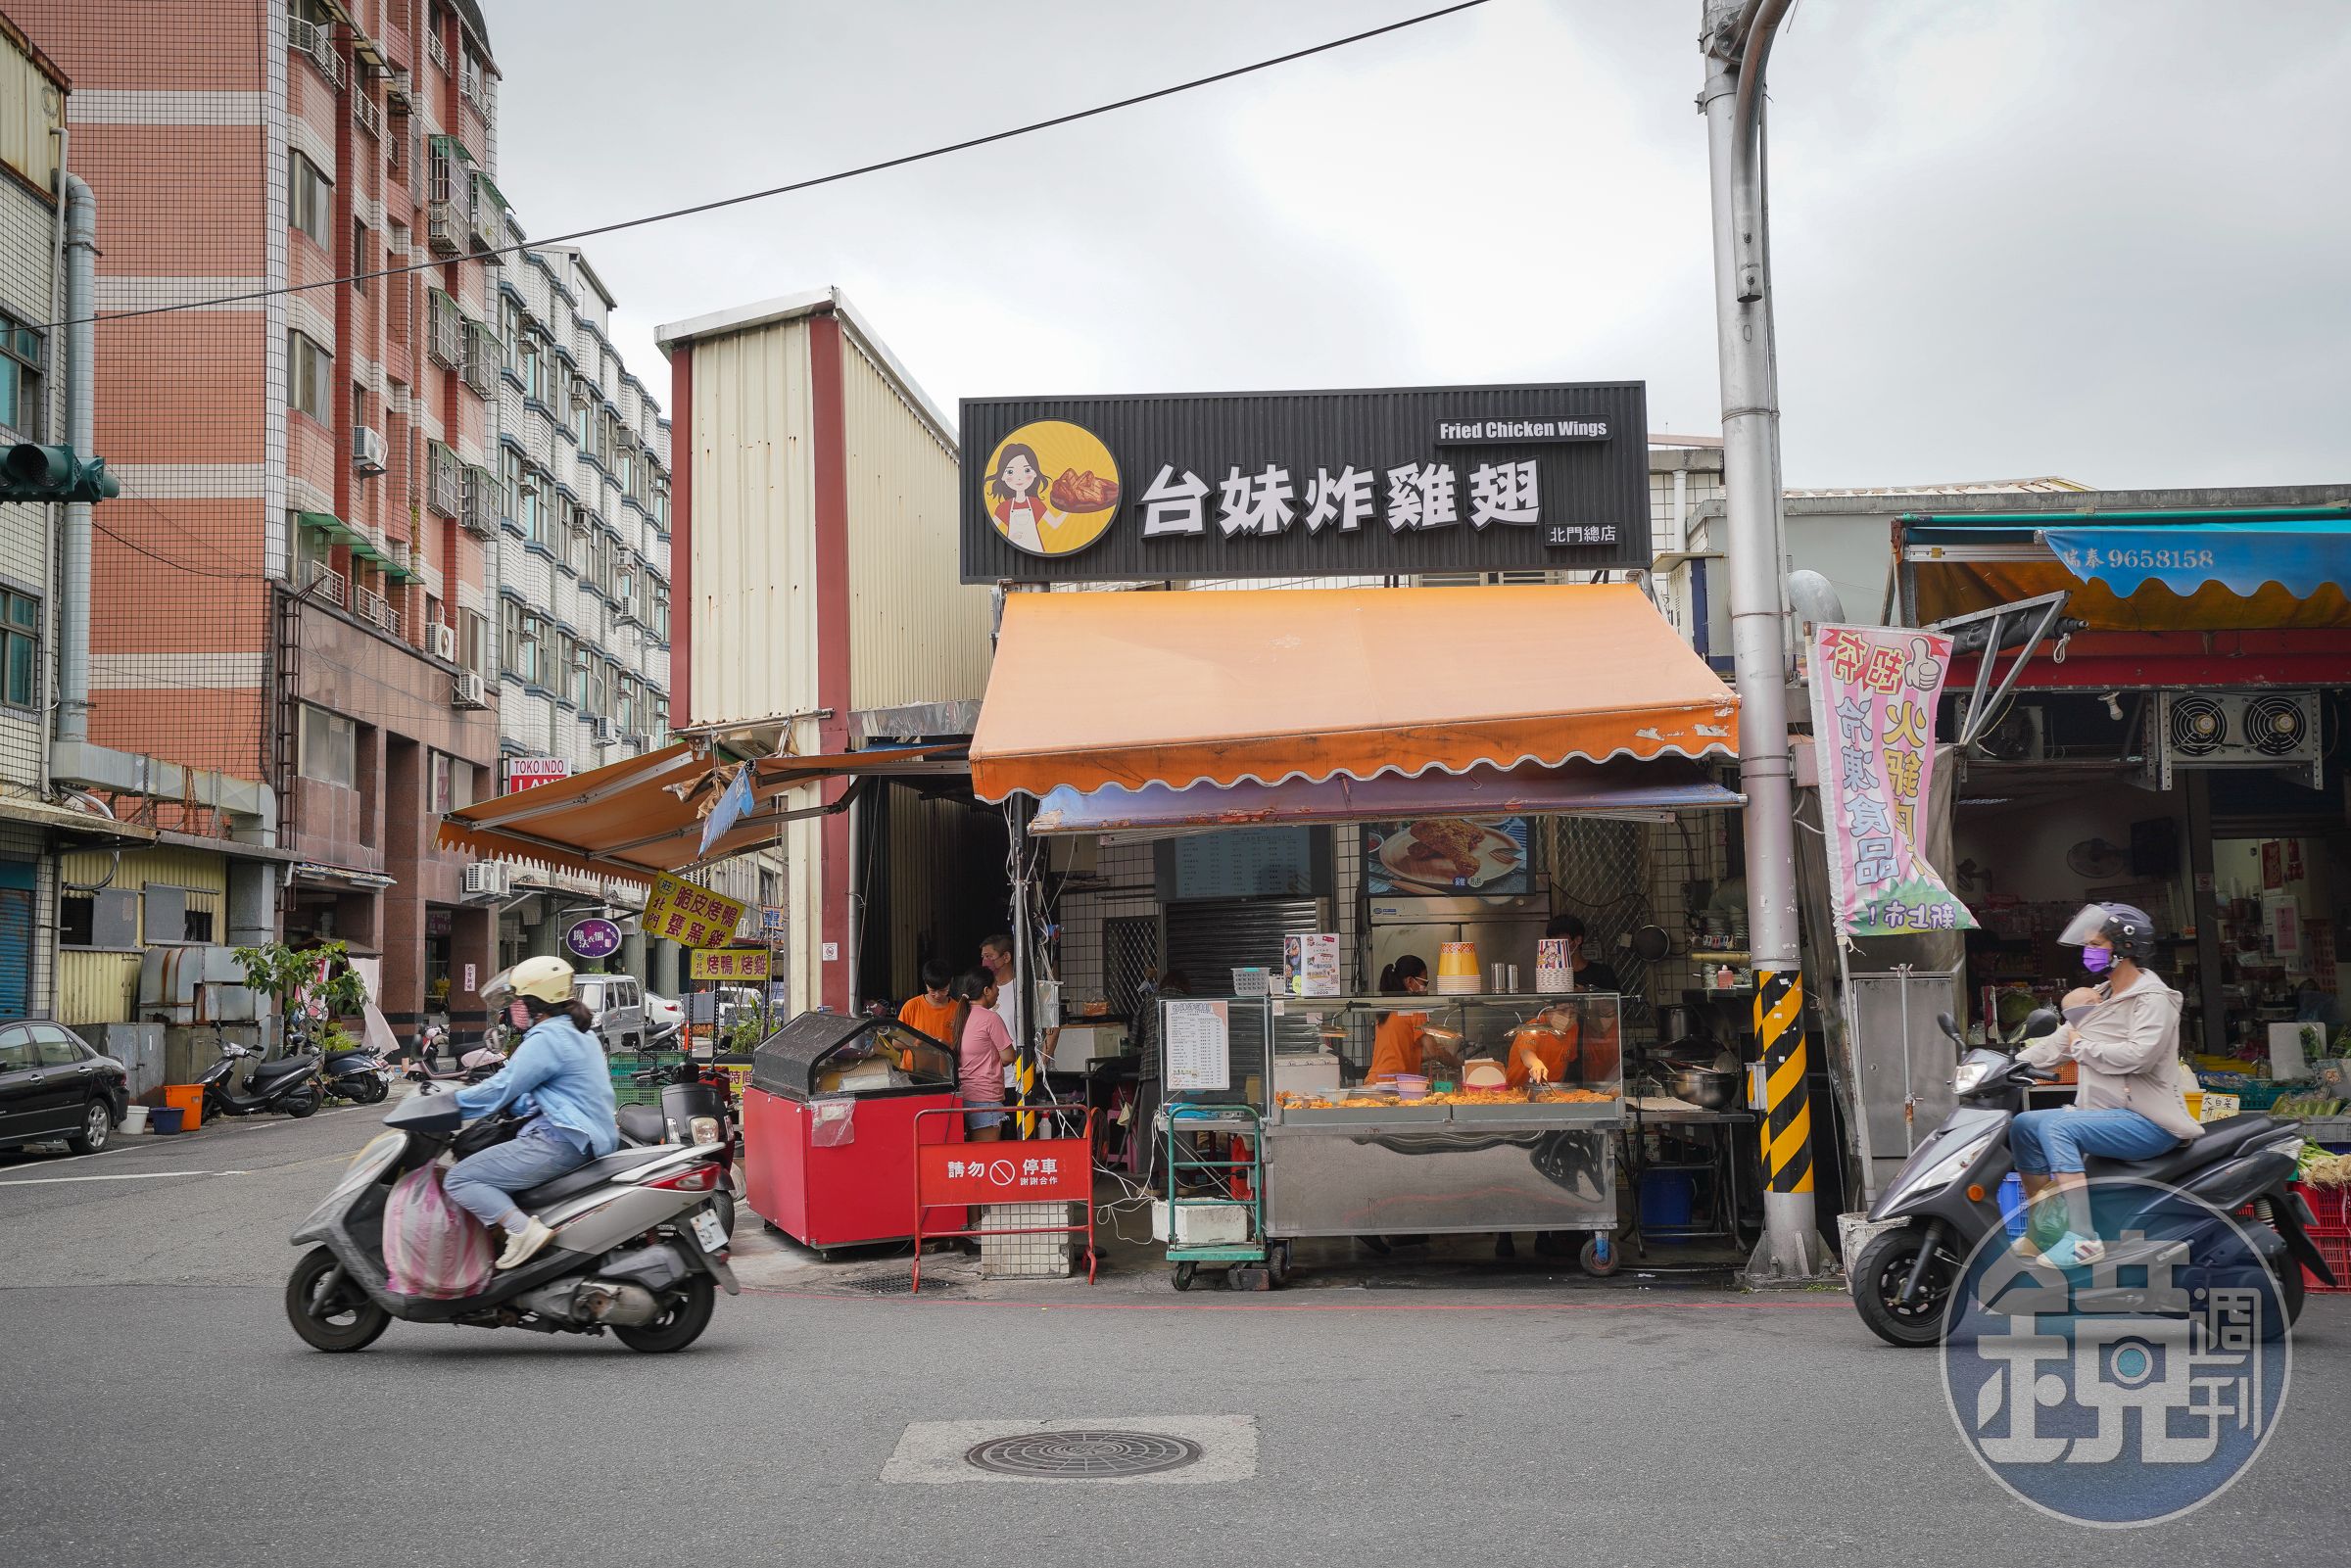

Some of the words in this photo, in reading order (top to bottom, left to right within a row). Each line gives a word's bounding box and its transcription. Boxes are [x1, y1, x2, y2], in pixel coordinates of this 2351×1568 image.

[1440, 422, 1481, 440] Fried
[1486, 420, 1554, 439] Chicken
[1558, 419, 1607, 440] Wings
[1142, 458, 1540, 536] 台妹炸雞翅
[1550, 523, 1617, 545] 北門總店
[2108, 549, 2214, 569] 9658158
[514, 760, 540, 774] TOKO
[542, 760, 564, 774] INDO
[647, 897, 666, 929] 北門
[673, 885, 740, 928] 脆皮烤鴨
[2203, 1096, 2232, 1111] 大白菜
[947, 1161, 985, 1179] 請勿
[1023, 1158, 1058, 1175] 停車
[1020, 1176, 1059, 1186] 謝謝合作
